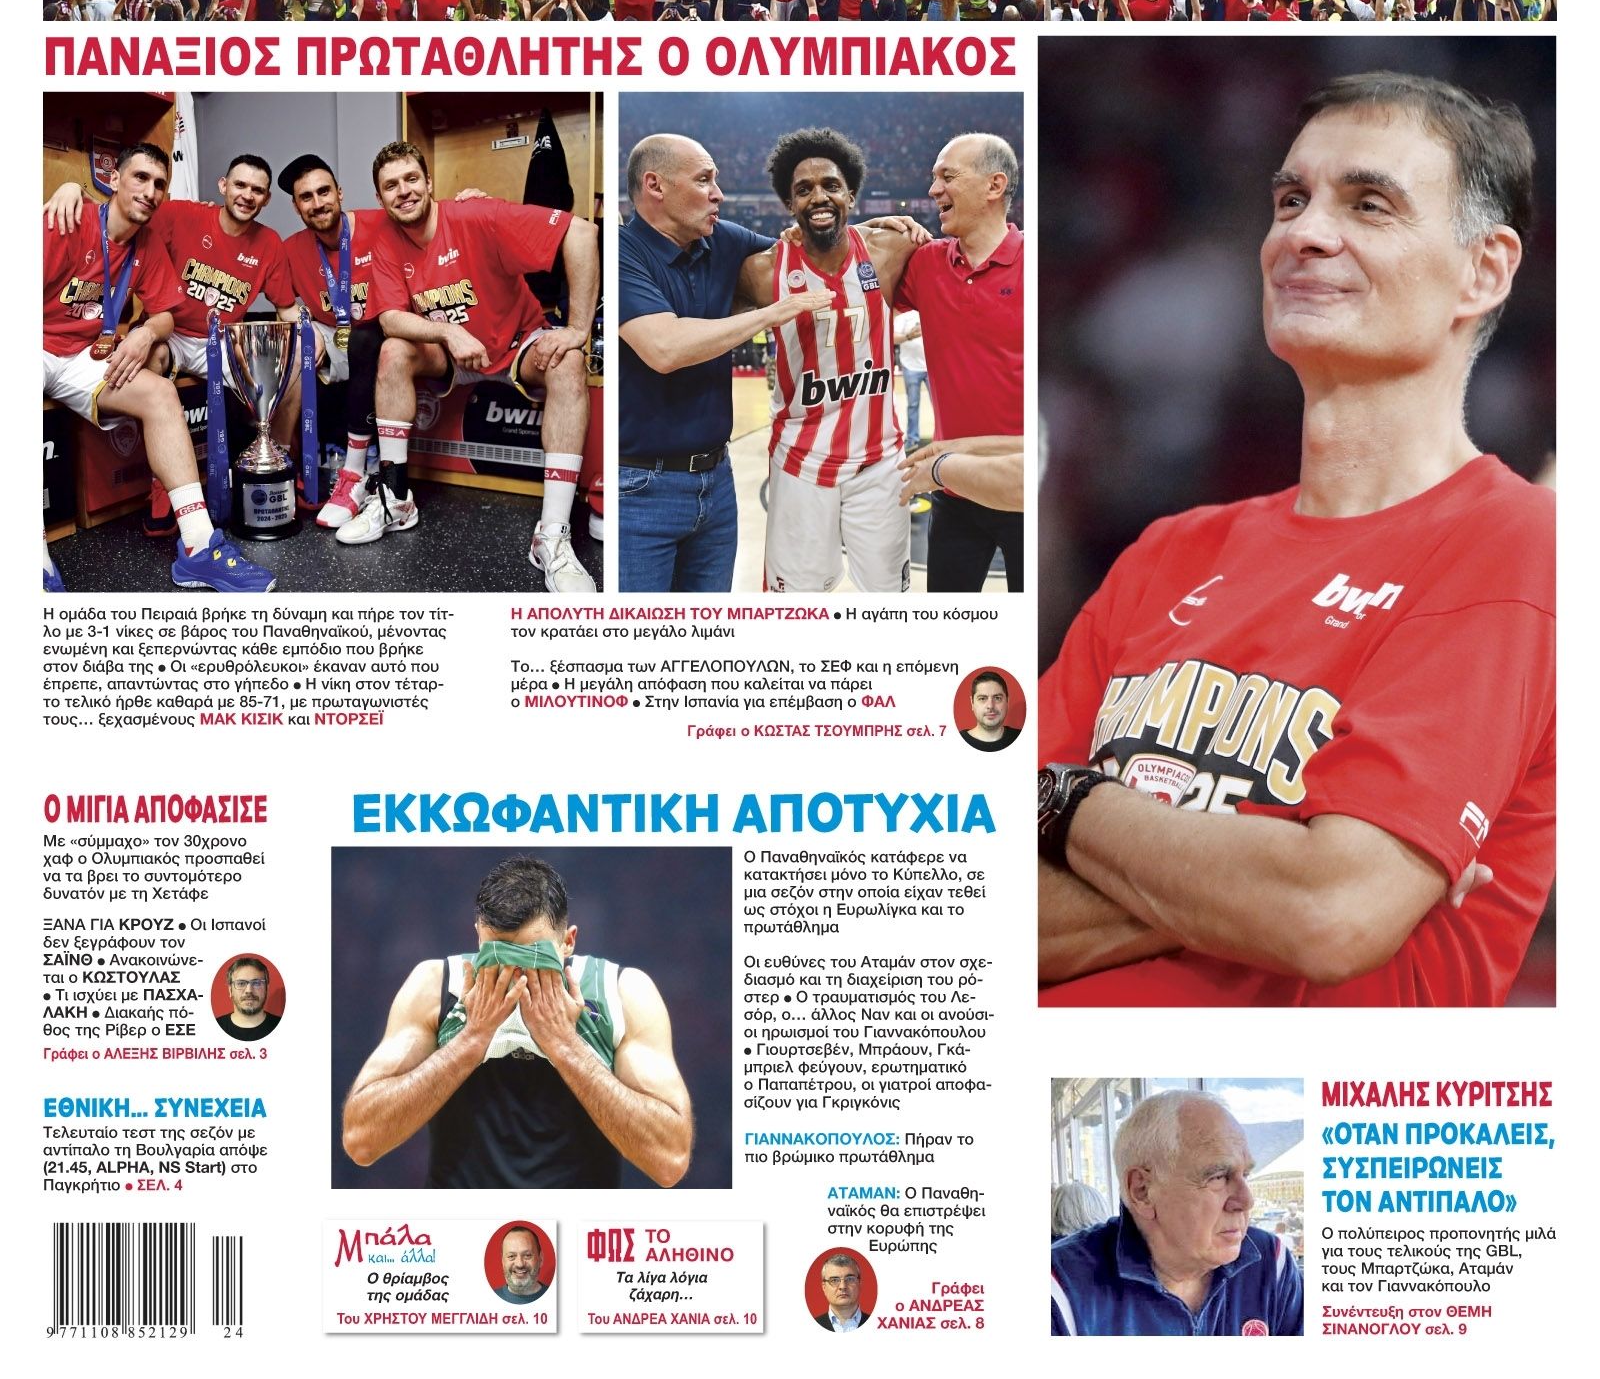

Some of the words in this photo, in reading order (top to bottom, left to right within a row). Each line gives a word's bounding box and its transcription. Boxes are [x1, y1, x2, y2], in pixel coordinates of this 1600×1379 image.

[46, 37, 280, 76] ΠΑΝΑΞΙΟΣ
[298, 37, 642, 76] ΠΡΩΤΑΘΛΗΤΗΣ
[659, 37, 689, 76] Ο
[706, 37, 1015, 76] ΟΛΥΜΠΙΑΚΟΣ
[182, 258, 251, 305] CHAMPIONS
[815, 306, 866, 348] 77
[801, 359, 891, 408] bwin
[486, 401, 543, 424] bwi
[688, 725, 735, 739] Γράφει
[740, 727, 750, 737] ο
[755, 725, 810, 736] ΚΩΣΤΑΣ
[815, 725, 902, 736] ΤΣΟΥΜΠΡΗΣ
[907, 725, 934, 736] σελ.
[939, 725, 947, 737] 7
[1090, 659, 1344, 806] HAMPIONS
[45, 794, 60, 823] Ο
[67, 795, 129, 823] ΜΙΓΙΑ
[134, 794, 266, 823] ΑΠΟΦΑΣΙΣΕ
[354, 792, 718, 833] ΕΚΚΩΦΑΝΤΙΚΗ
[733, 792, 996, 833] ΑΠΟΤΥΧΙΑ
[44, 1048, 88, 1061] Γράφει
[92, 1050, 101, 1060] ο
[104, 1048, 158, 1059] ΑΛΕΞΗΣ
[163, 1048, 225, 1059] ΒΙΡΒΙΛΗΣ
[230, 1048, 255, 1059] σελ.
[259, 1047, 268, 1060] 3
[1322, 1081, 1429, 1107] ΜΙΧΑΛΗΣ
[1437, 1081, 1552, 1107] ΚΥΡΙΤΣΗΣ
[44, 1097, 148, 1117] ΕΘΝΙΚΗ...
[155, 1098, 266, 1117] ΣΥΝΕΧΕΙΑ
[746, 1133, 899, 1145] ΓΙΑΝΝΑΚΟΠΟΥΛΟΣ:
[906, 1133, 952, 1148] Πήραν
[957, 1136, 973, 1145] το
[1322, 1122, 1398, 1145] «ΟΤΑΝ
[1406, 1122, 1554, 1149] ΠΡΟΚΑΛΕΙΣ,
[44, 1161, 91, 1176] (21.45,
[97, 1161, 153, 1175] ALPHA,
[159, 1161, 180, 1173] NS
[186, 1161, 225, 1176] Start)
[231, 1164, 257, 1173] στο
[1323, 1156, 1502, 1179] ΣΥΣΠΕΙΡΩΝΕΙΣ
[1322, 1190, 1371, 1212] ΤΟΝ
[1378, 1190, 1516, 1212] ΑΝΤΙΠΑΛΟ»
[335, 1224, 432, 1268] Μπάλα
[588, 1229, 634, 1262] ΦΩΣ
[645, 1229, 670, 1243] ΤΟ
[401, 1248, 436, 1264] άλλα!
[646, 1248, 733, 1261] ΑΛΗΘΙΝΟ
[931, 1281, 986, 1297] Γράφει
[895, 1303, 904, 1313] ο
[910, 1299, 986, 1313] ΑΝΔΡΕΑΣ
[1323, 1306, 1403, 1319] Συνέντευξη
[1408, 1308, 1442, 1318] στον
[1447, 1306, 1491, 1317] ΘΕΜΗ
[223, 1326, 243, 1339] 24
[878, 1317, 935, 1328] ΧΑΝΙΑΣ
[941, 1317, 970, 1329] σελ.
[975, 1316, 985, 1330] 8
[1323, 1323, 1421, 1334] ΣΙΝΑΝΟΓΛΟΥ
[1426, 1324, 1453, 1334] σελ.
[1458, 1323, 1468, 1335] 9
